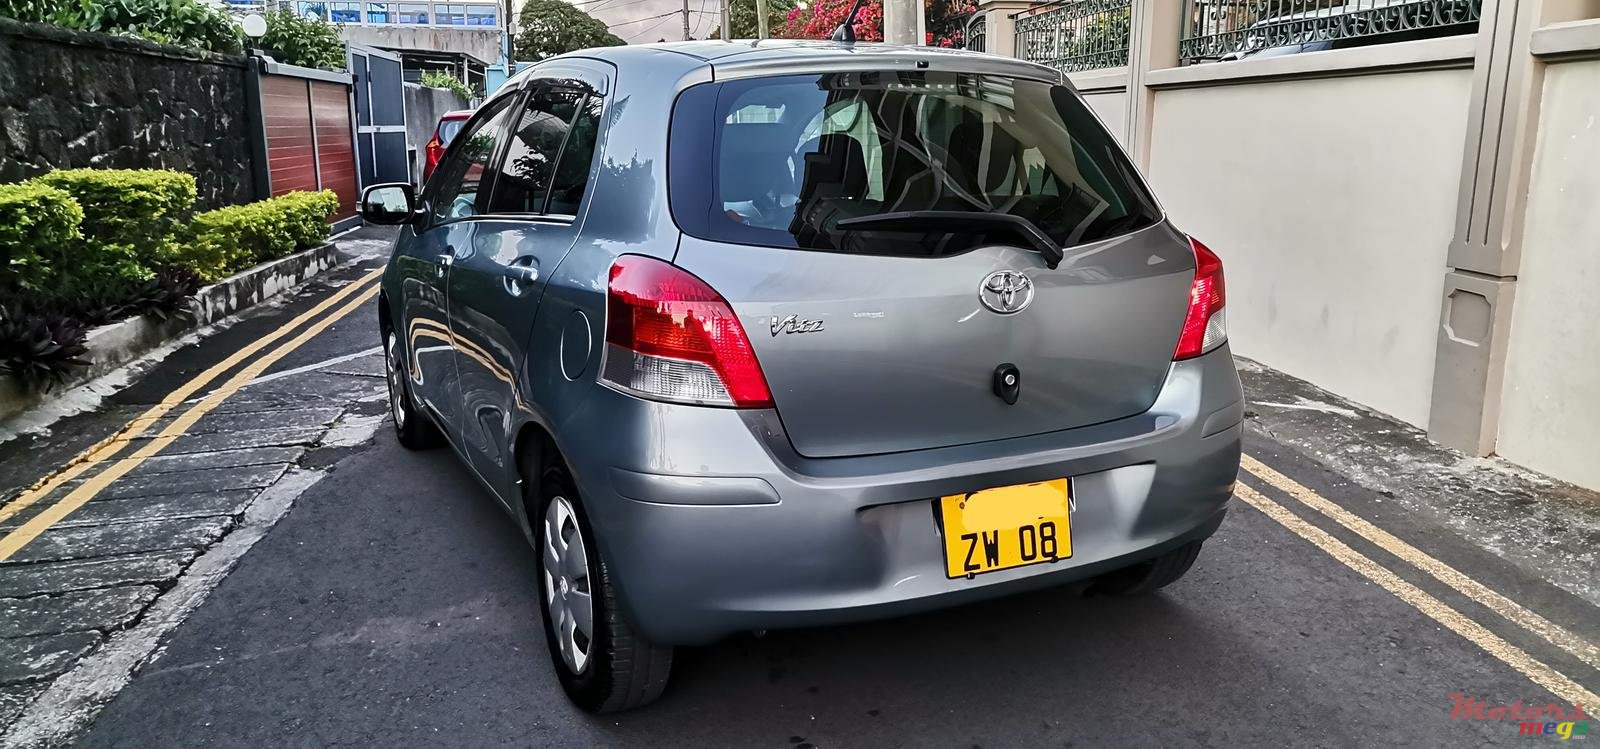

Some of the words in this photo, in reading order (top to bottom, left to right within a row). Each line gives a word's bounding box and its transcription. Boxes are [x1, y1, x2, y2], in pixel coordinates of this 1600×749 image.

[770, 314, 824, 337] Vitz
[961, 530, 999, 571] ZW
[1019, 521, 1058, 561] 08
